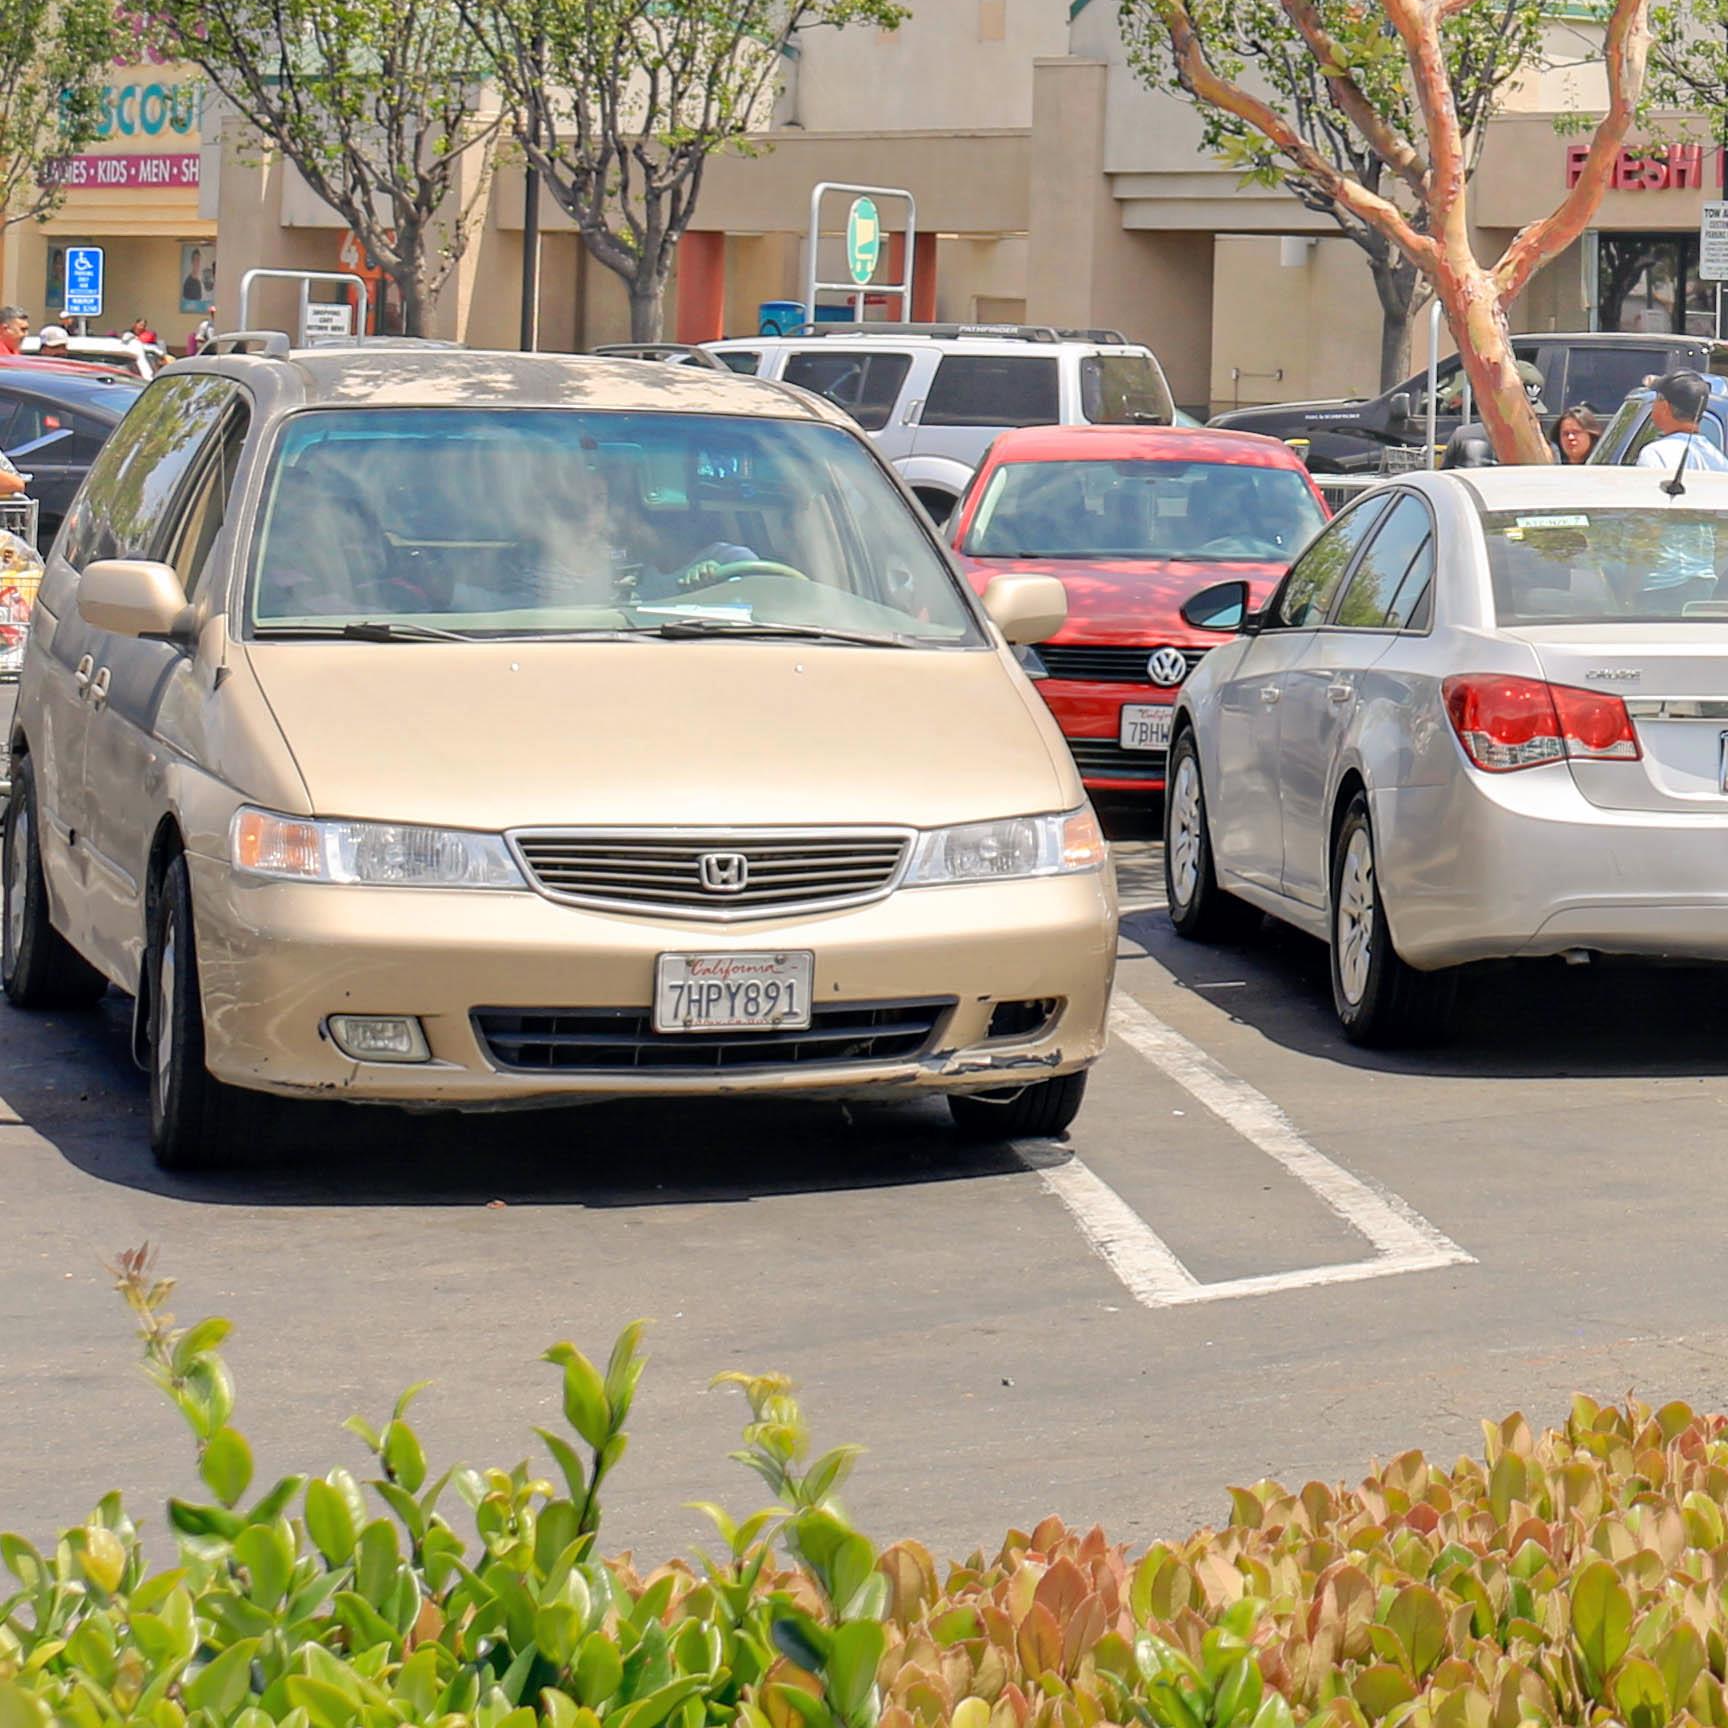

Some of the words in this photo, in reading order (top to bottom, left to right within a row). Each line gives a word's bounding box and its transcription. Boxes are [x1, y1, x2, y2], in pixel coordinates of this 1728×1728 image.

[97, 160, 128, 184] KIDS
[138, 159, 170, 183] MEN
[1567, 143, 1702, 189] FESH
[691, 959, 781, 980] California
[668, 980, 801, 1020] 7HPY891
